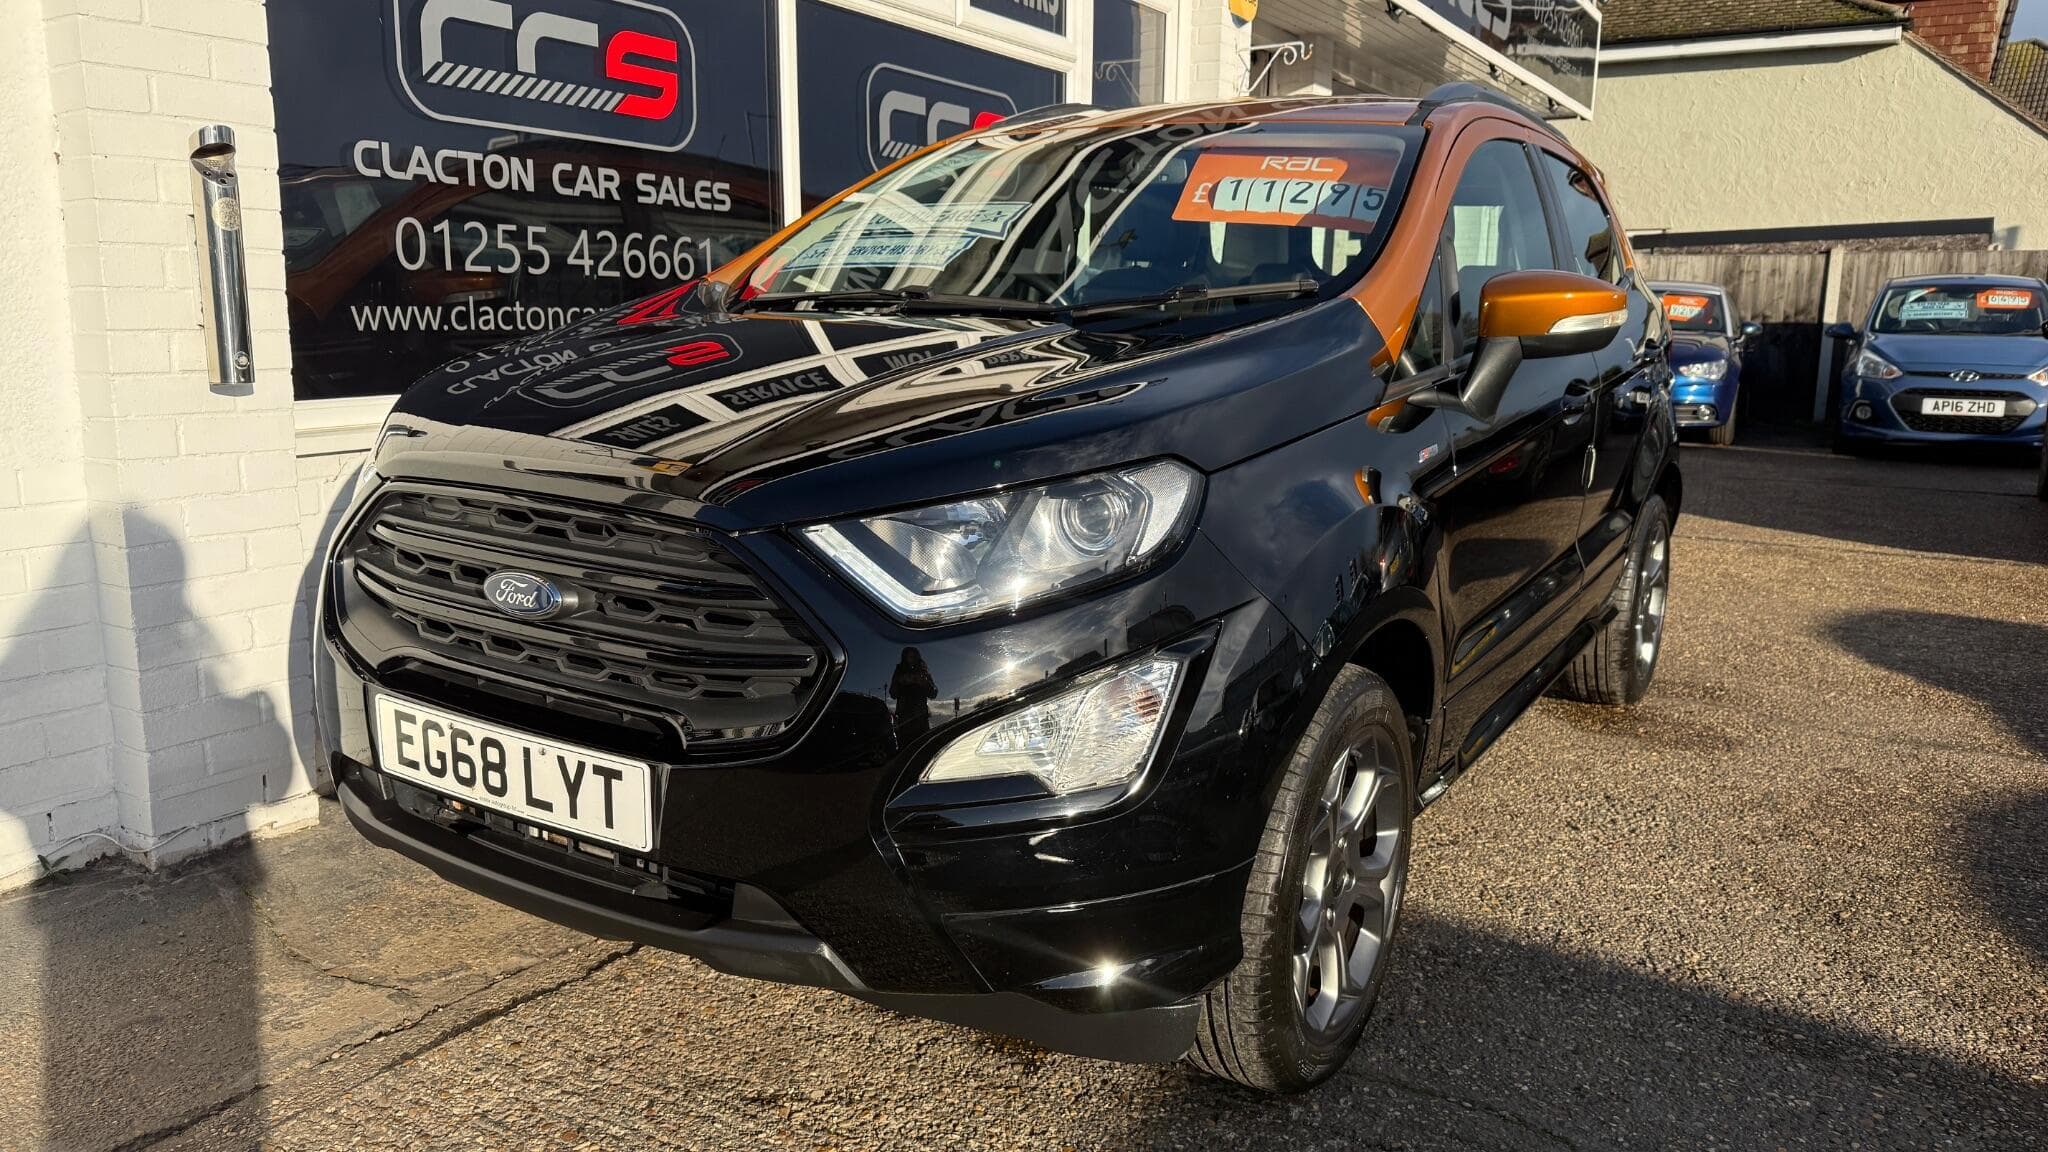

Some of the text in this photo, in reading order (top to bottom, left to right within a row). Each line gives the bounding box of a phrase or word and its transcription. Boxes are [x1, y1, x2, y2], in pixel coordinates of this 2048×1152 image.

[879, 90, 1008, 150] CC
[353, 139, 732, 212] CLACTON CAR SALES
[395, 216, 712, 281] 01255 426661
[1933, 400, 1996, 413] AP16 ZHD
[495, 578, 538, 608] Ford
[393, 708, 623, 830] EG68 LYT
